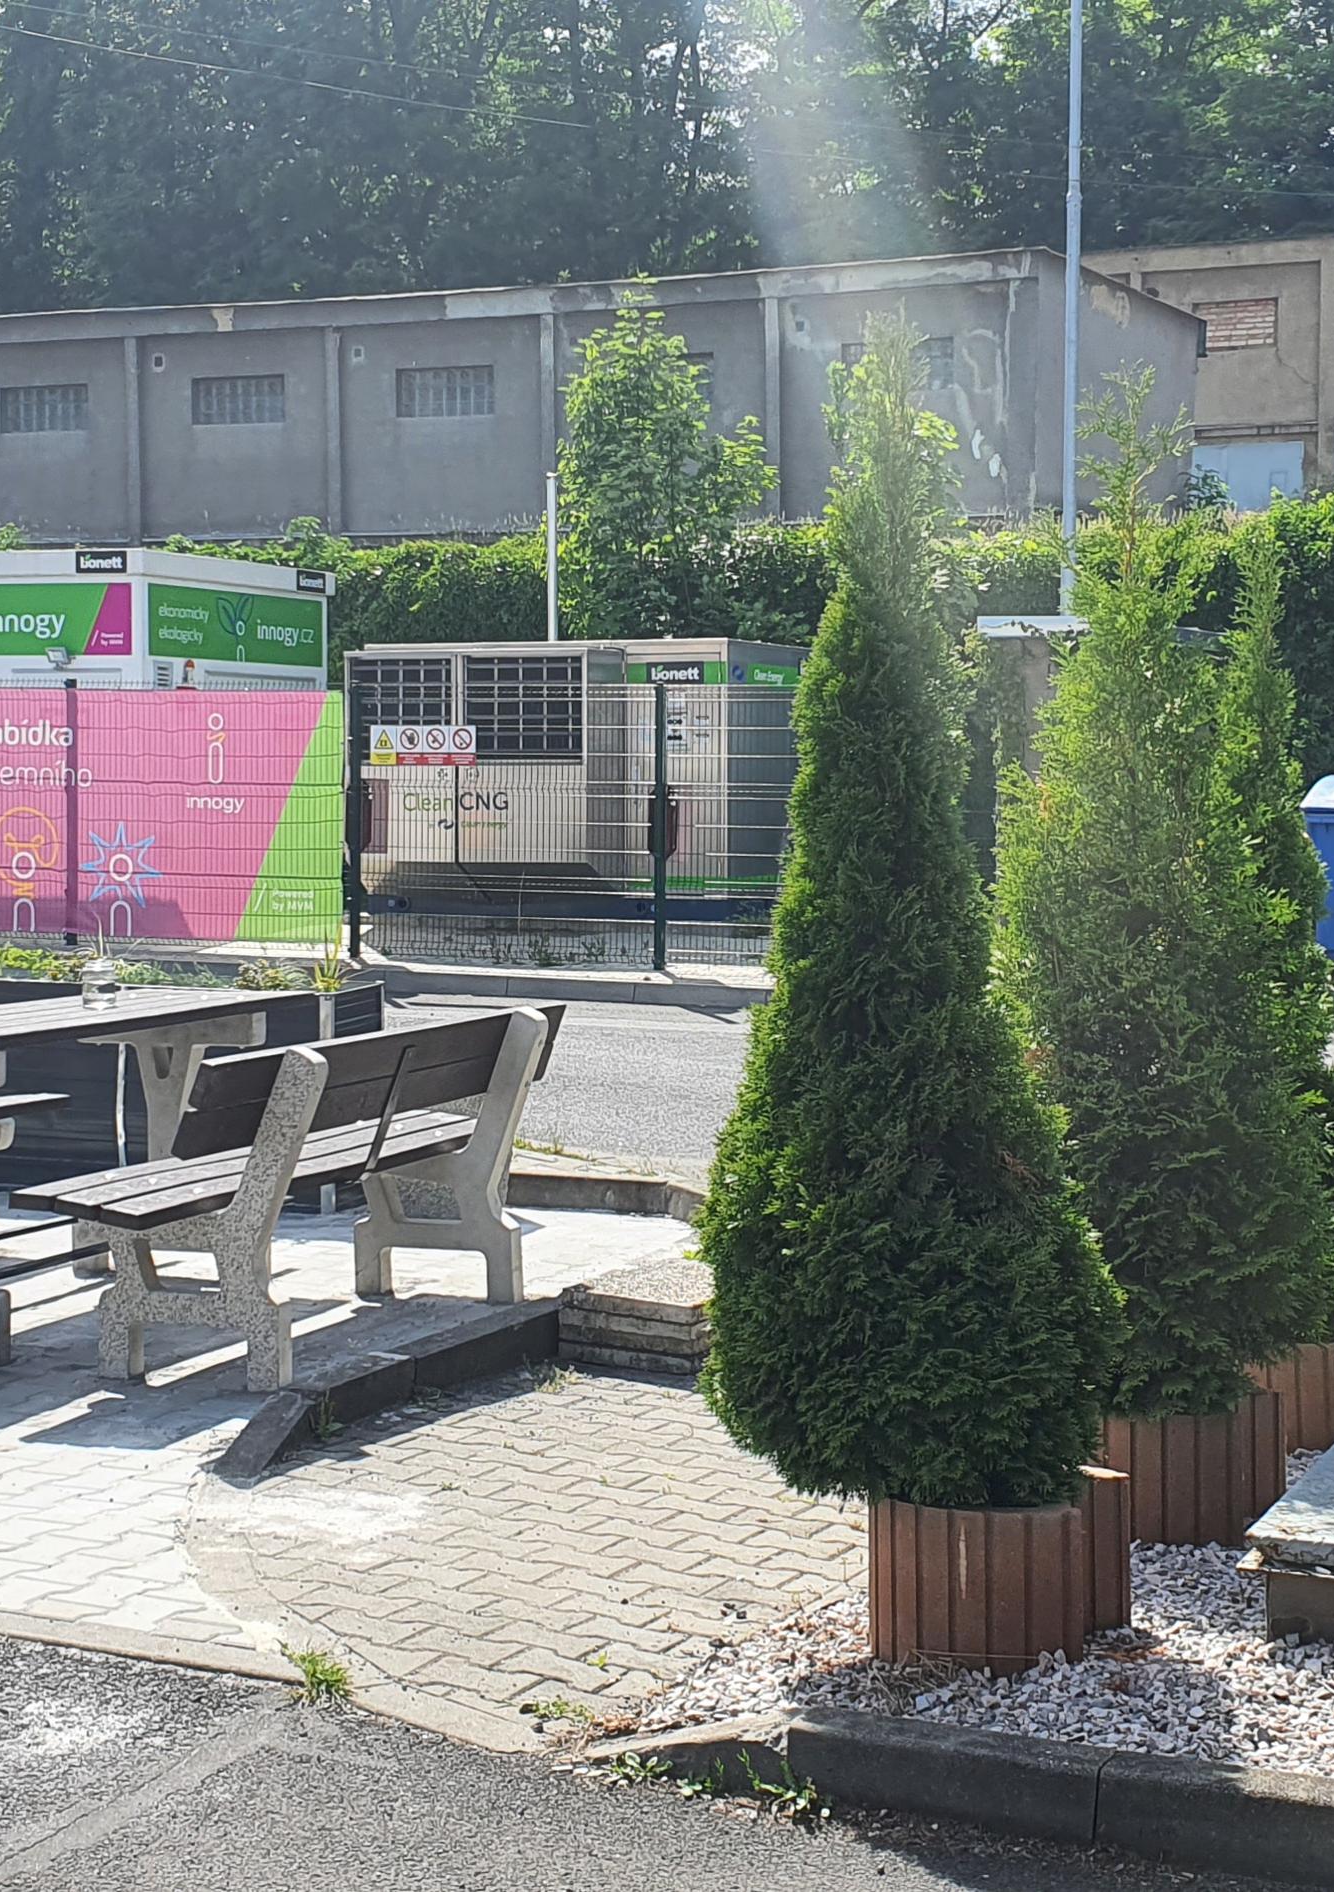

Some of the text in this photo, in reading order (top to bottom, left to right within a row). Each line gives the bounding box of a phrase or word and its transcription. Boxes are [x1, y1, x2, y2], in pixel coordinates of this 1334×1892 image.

[79, 555, 123, 569] bonett
[158, 602, 210, 624] ekonomicky
[256, 619, 315, 647] innogy.cz
[651, 664, 700, 681] bonett
[185, 791, 245, 814] innogy
[403, 791, 509, 812] Clean CNG
